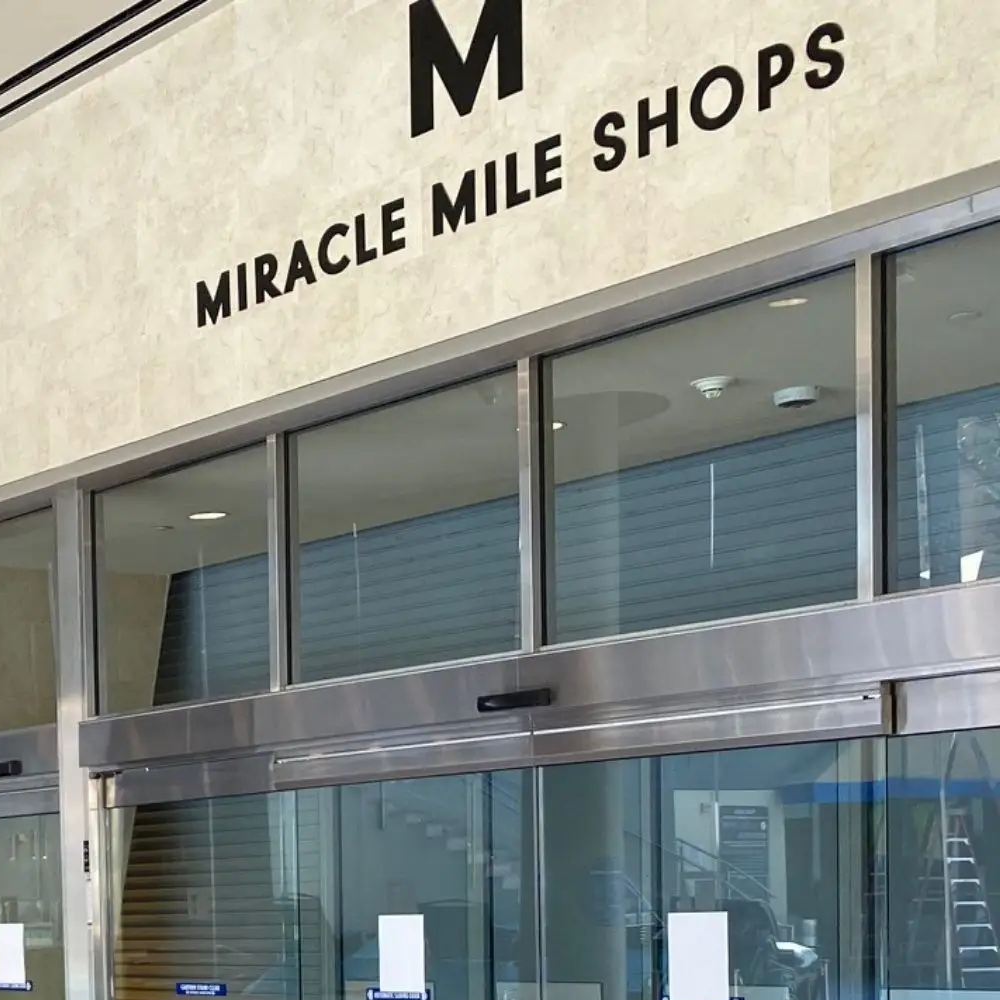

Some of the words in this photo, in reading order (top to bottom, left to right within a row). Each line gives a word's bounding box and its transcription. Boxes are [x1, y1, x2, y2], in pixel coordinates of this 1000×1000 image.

[196, 197, 406, 328] MIRACLE
[432, 134, 562, 237] MILE
[593, 22, 845, 172] SHOPS
[409, 0, 523, 138] M
